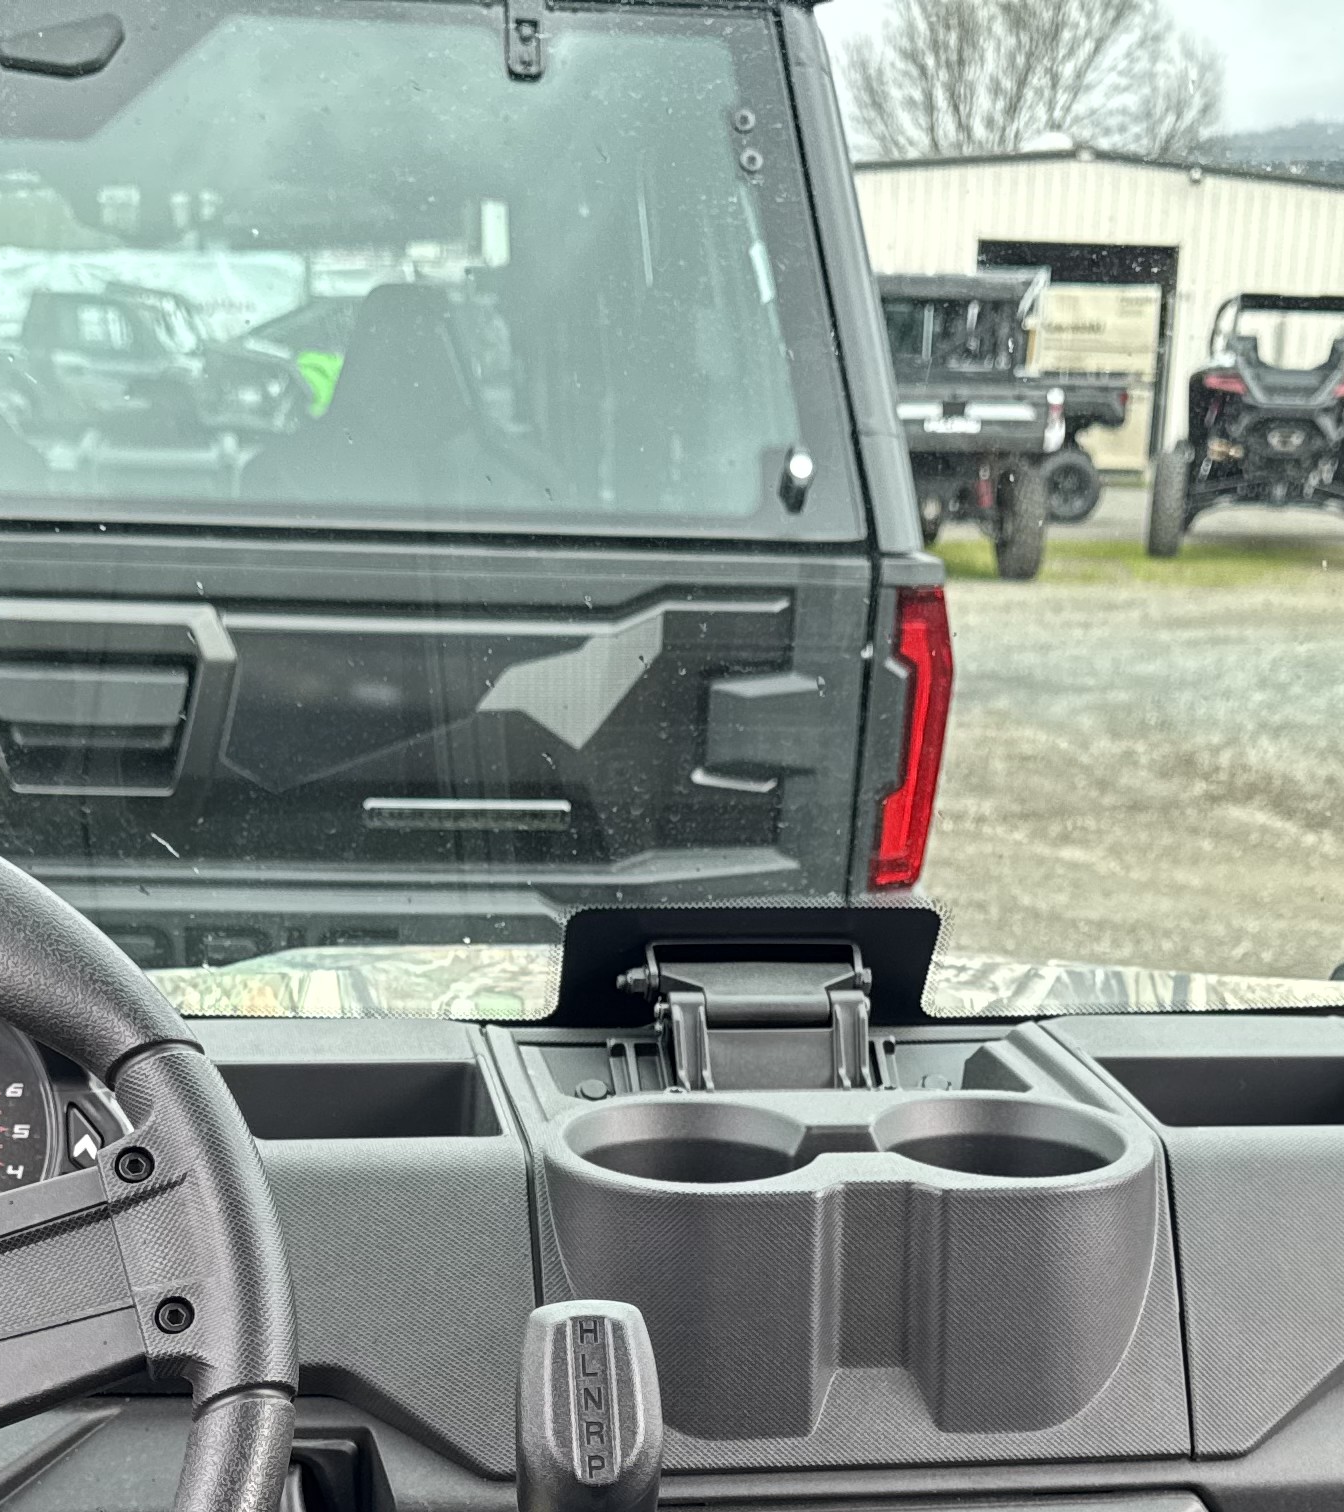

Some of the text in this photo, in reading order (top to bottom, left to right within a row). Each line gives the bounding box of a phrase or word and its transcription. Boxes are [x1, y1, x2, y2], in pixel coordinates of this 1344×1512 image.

[6, 1082, 24, 1097] 6
[12, 1124, 31, 1139] 5
[6, 1164, 24, 1179] 4
